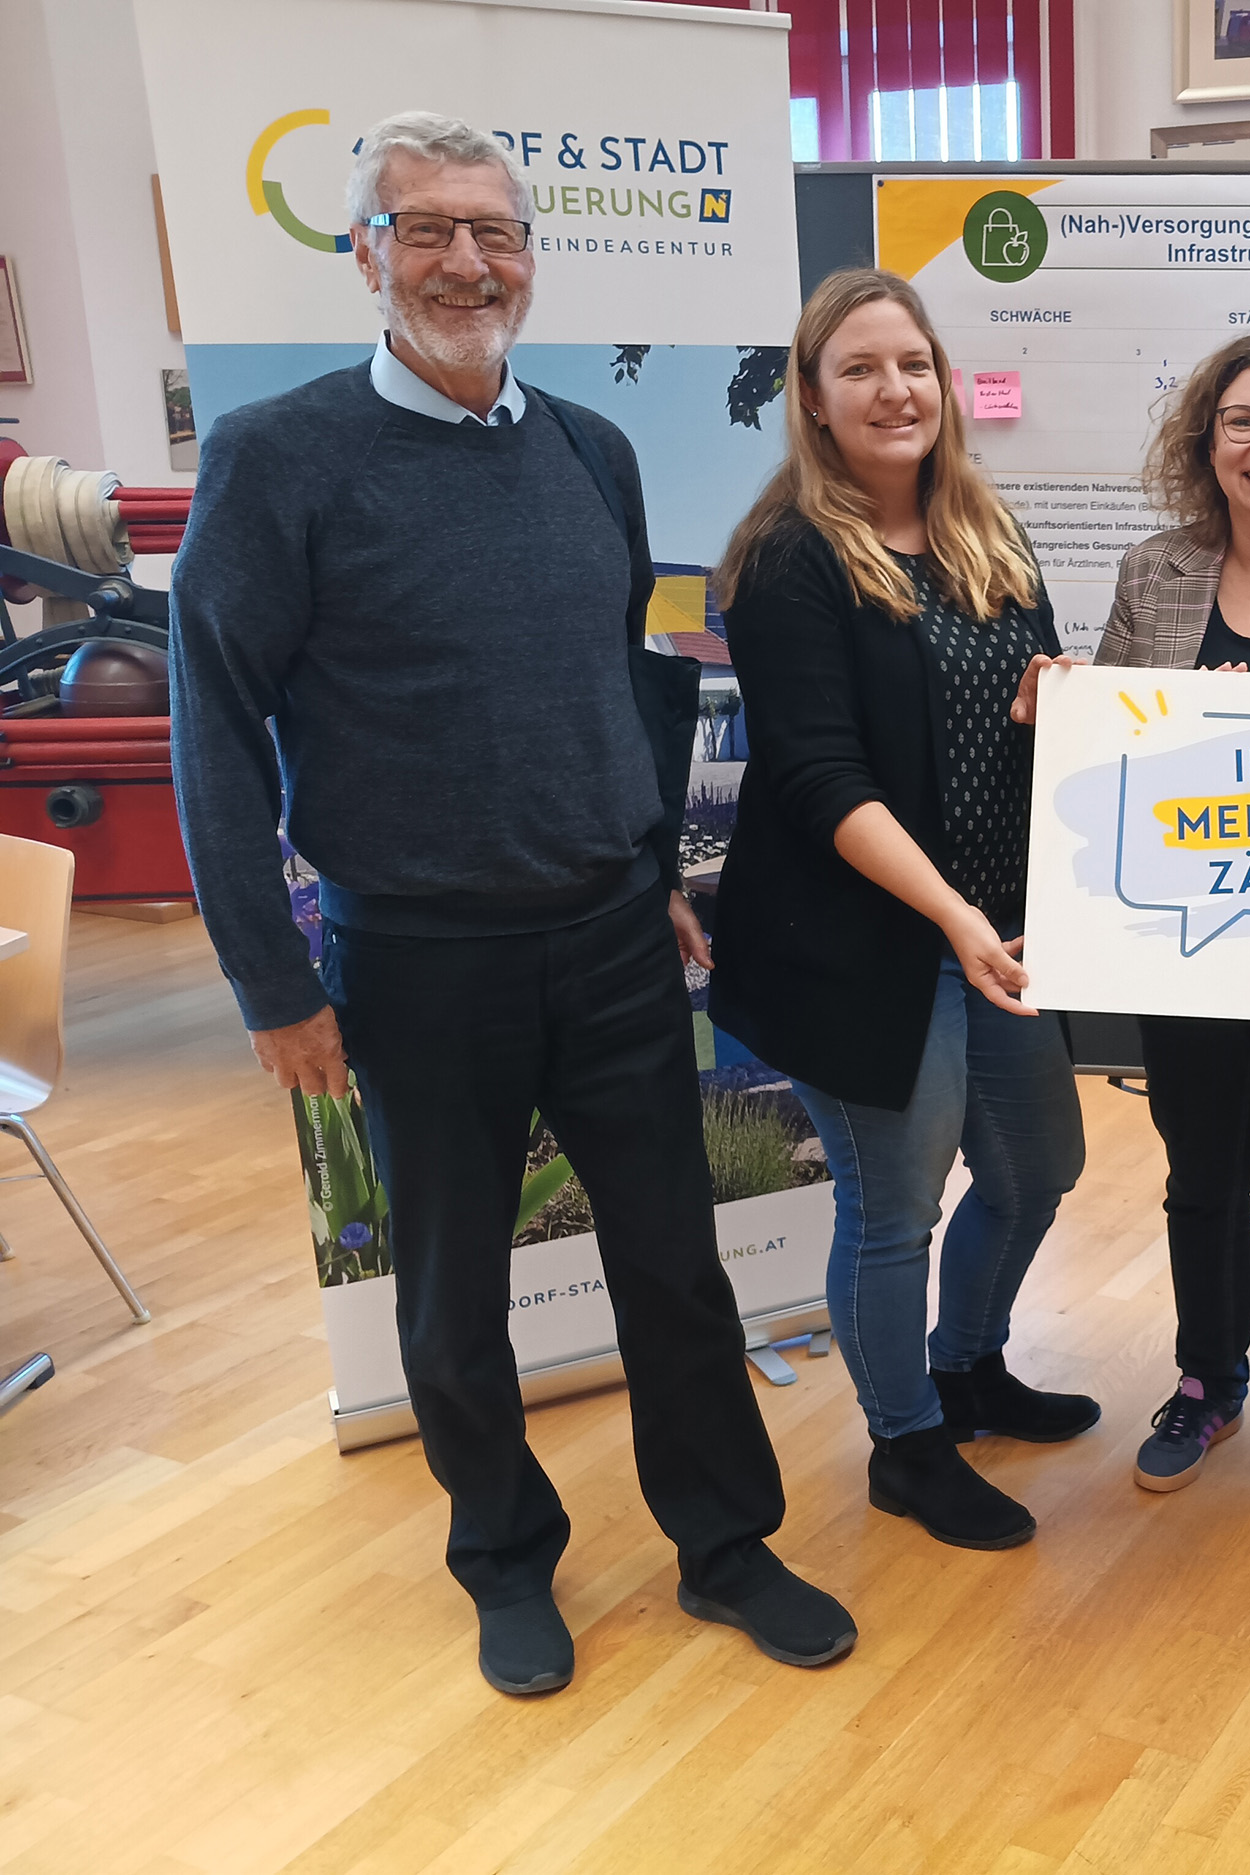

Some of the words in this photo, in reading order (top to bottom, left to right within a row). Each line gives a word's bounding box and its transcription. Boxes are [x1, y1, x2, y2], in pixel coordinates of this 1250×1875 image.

[557, 133, 587, 169] &
[600, 136, 729, 175] STADT
[989, 308, 1073, 323] SCHWÄCHE
[1135, 348, 1141, 356] 3
[1154, 376, 1179, 390] 3,2
[1023, 482, 1089, 491] existierenden
[1034, 501, 1048, 509] mit
[1051, 502, 1088, 510] unseren
[1090, 501, 1136, 511] Einkäufen
[1053, 559, 1065, 567] für
[316, 1162, 332, 1199] Gerald
